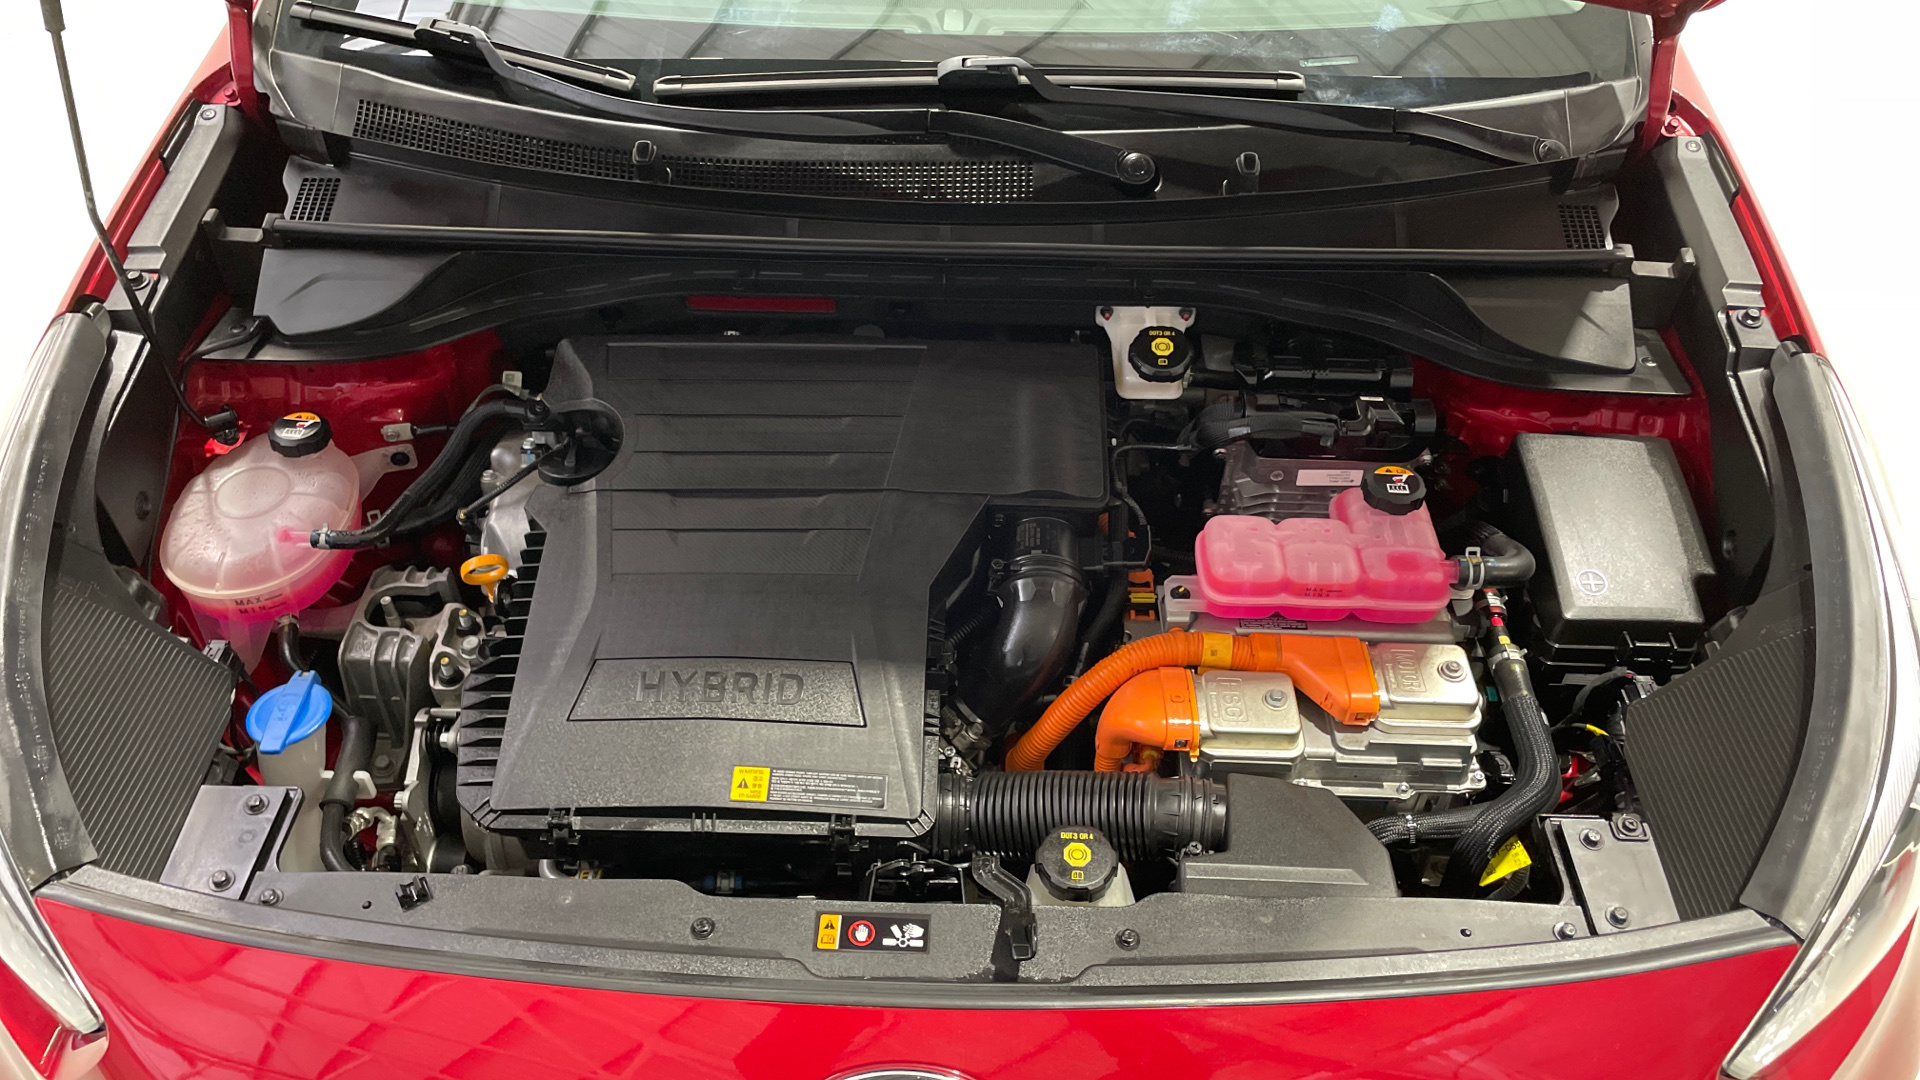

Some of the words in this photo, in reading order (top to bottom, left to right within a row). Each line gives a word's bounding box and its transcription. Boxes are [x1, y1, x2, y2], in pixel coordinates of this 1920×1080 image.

[234, 596, 263, 606] MAX
[238, 605, 266, 614] MIN
[634, 670, 804, 705] HYBRID
[1395, 653, 1421, 691] MOTOR
[1220, 682, 1244, 720] HSG
